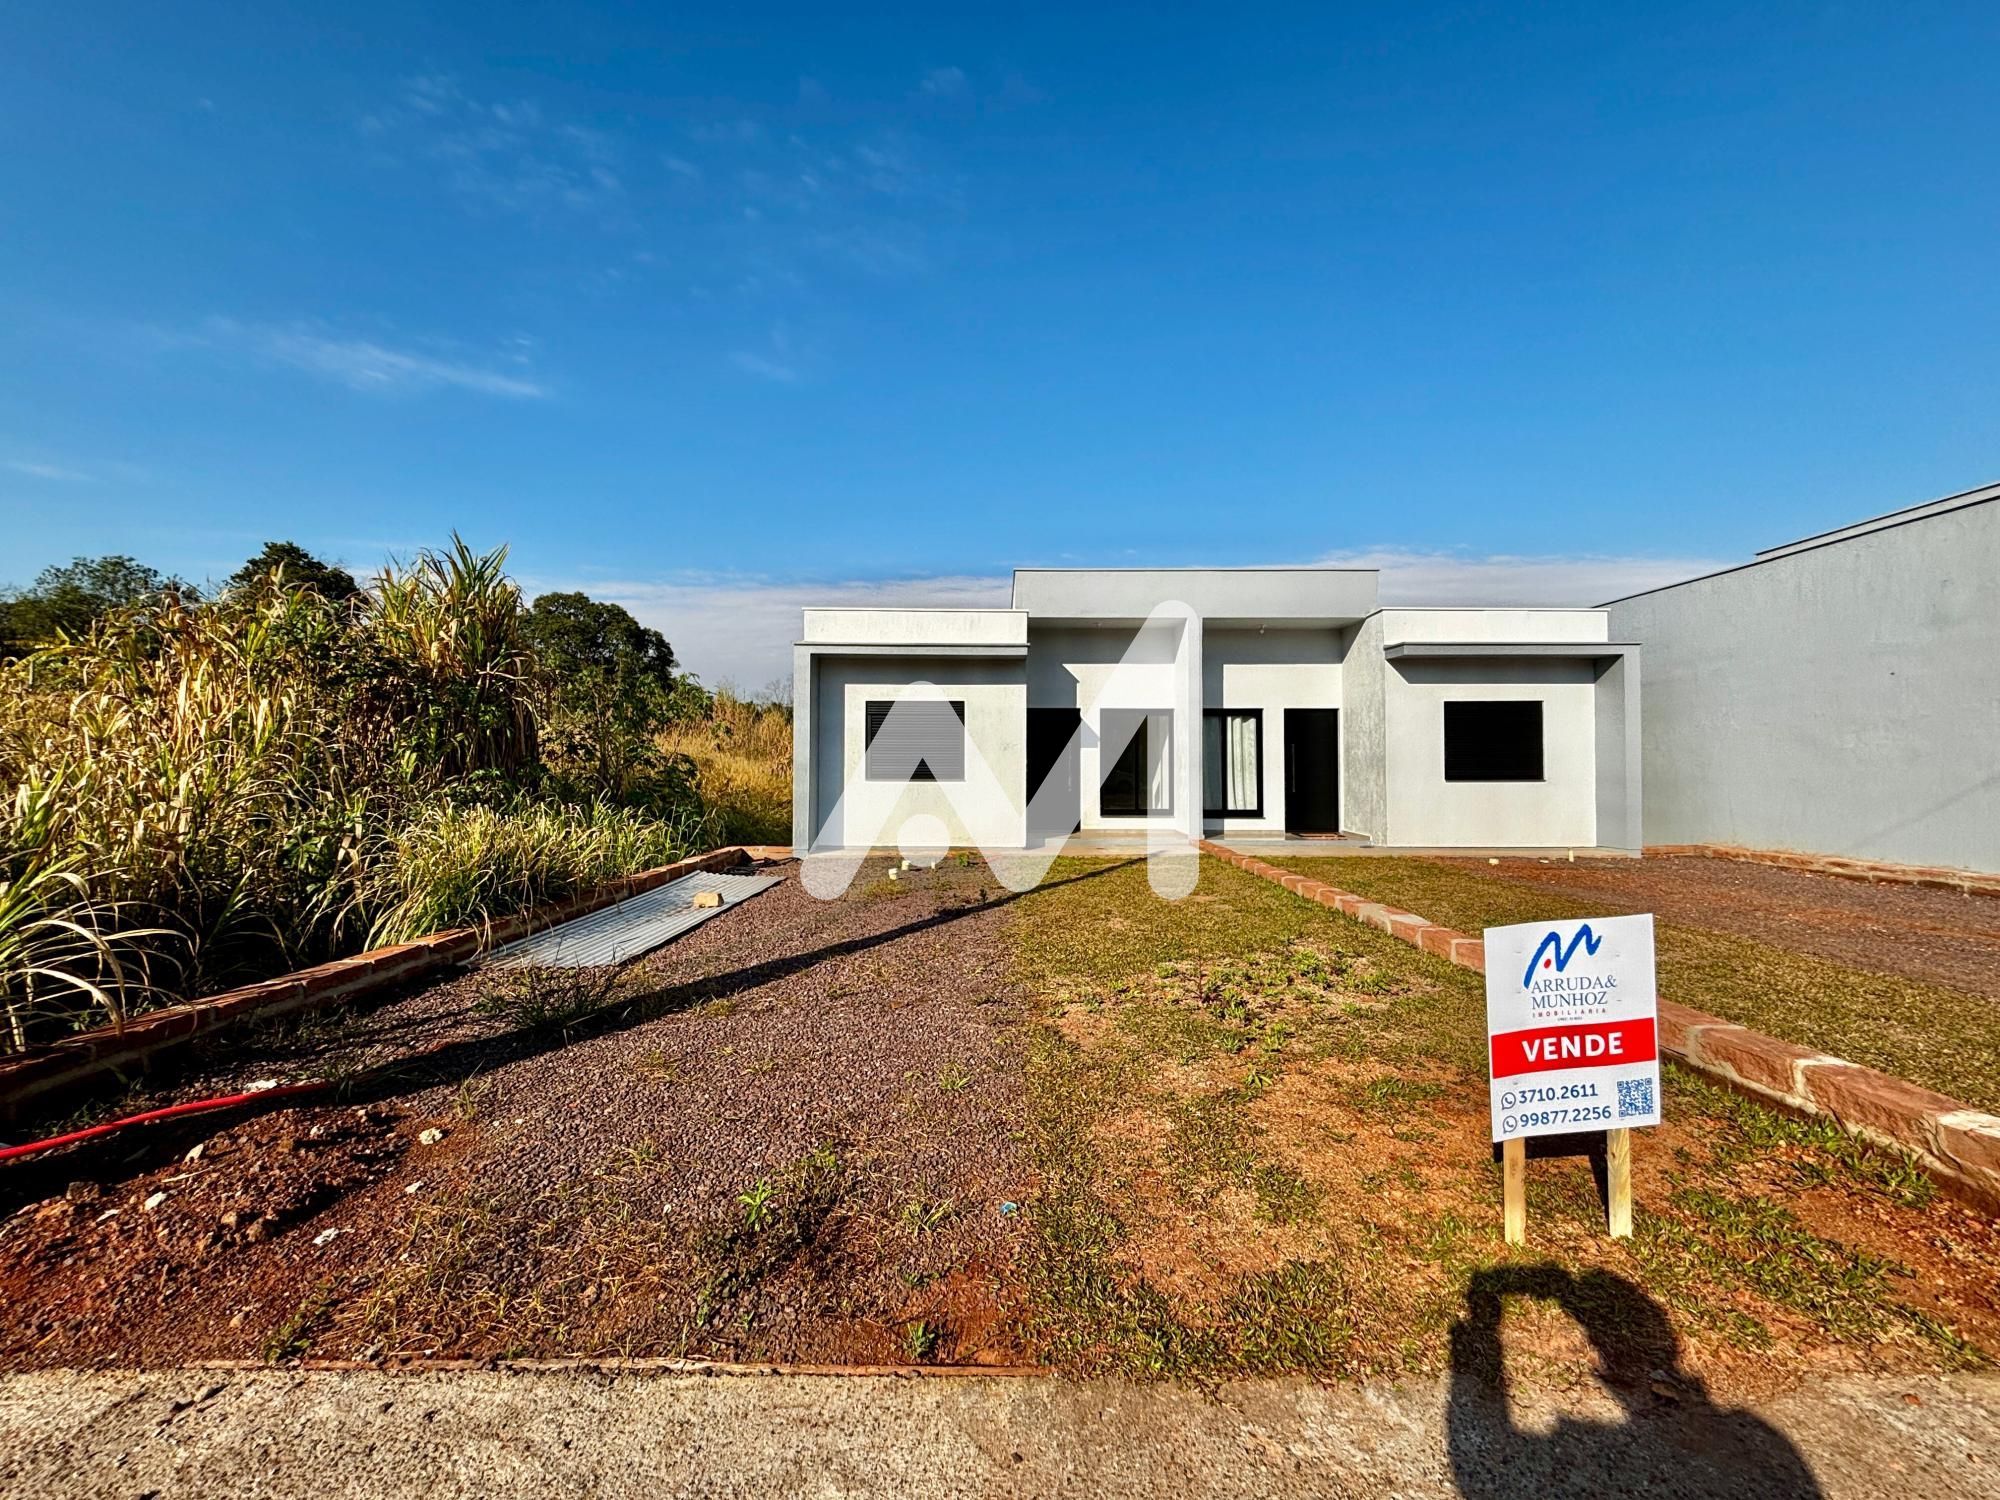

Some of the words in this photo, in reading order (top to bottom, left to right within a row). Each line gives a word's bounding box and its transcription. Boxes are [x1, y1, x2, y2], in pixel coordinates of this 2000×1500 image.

[1532, 991, 1608, 1010] MUNHOZ
[1532, 1008, 1607, 1018] IMOBILIARIA
[1521, 1031, 1623, 1062] VENDE
[1518, 1083, 1598, 1104] 3710.2611
[1519, 1105, 1612, 1128] 99877.2256
